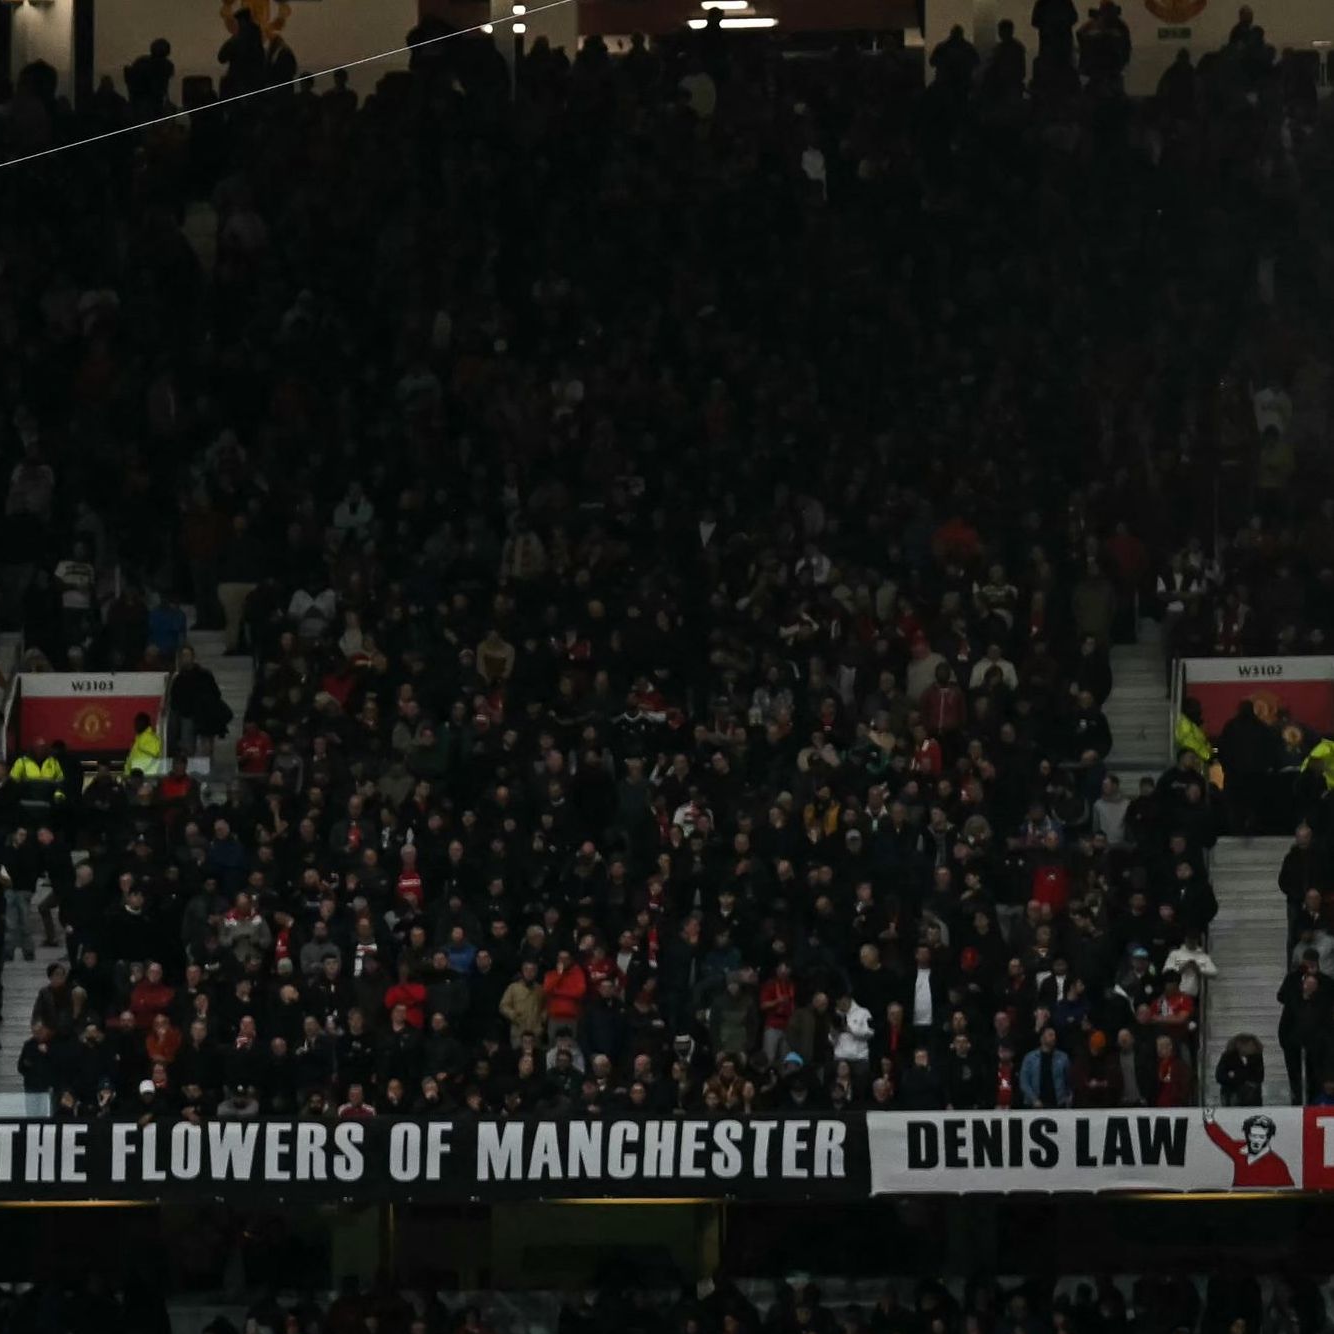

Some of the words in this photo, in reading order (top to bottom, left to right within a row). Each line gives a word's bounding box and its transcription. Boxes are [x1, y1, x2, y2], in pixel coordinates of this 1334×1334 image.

[71, 680, 114, 691] W3103
[111, 1120, 364, 1182] FLOWERS
[389, 1120, 453, 1181] OF
[477, 1119, 847, 1181] MANCHESTER
[907, 1116, 1060, 1169] DENIS
[1076, 1116, 1189, 1167] LAW
